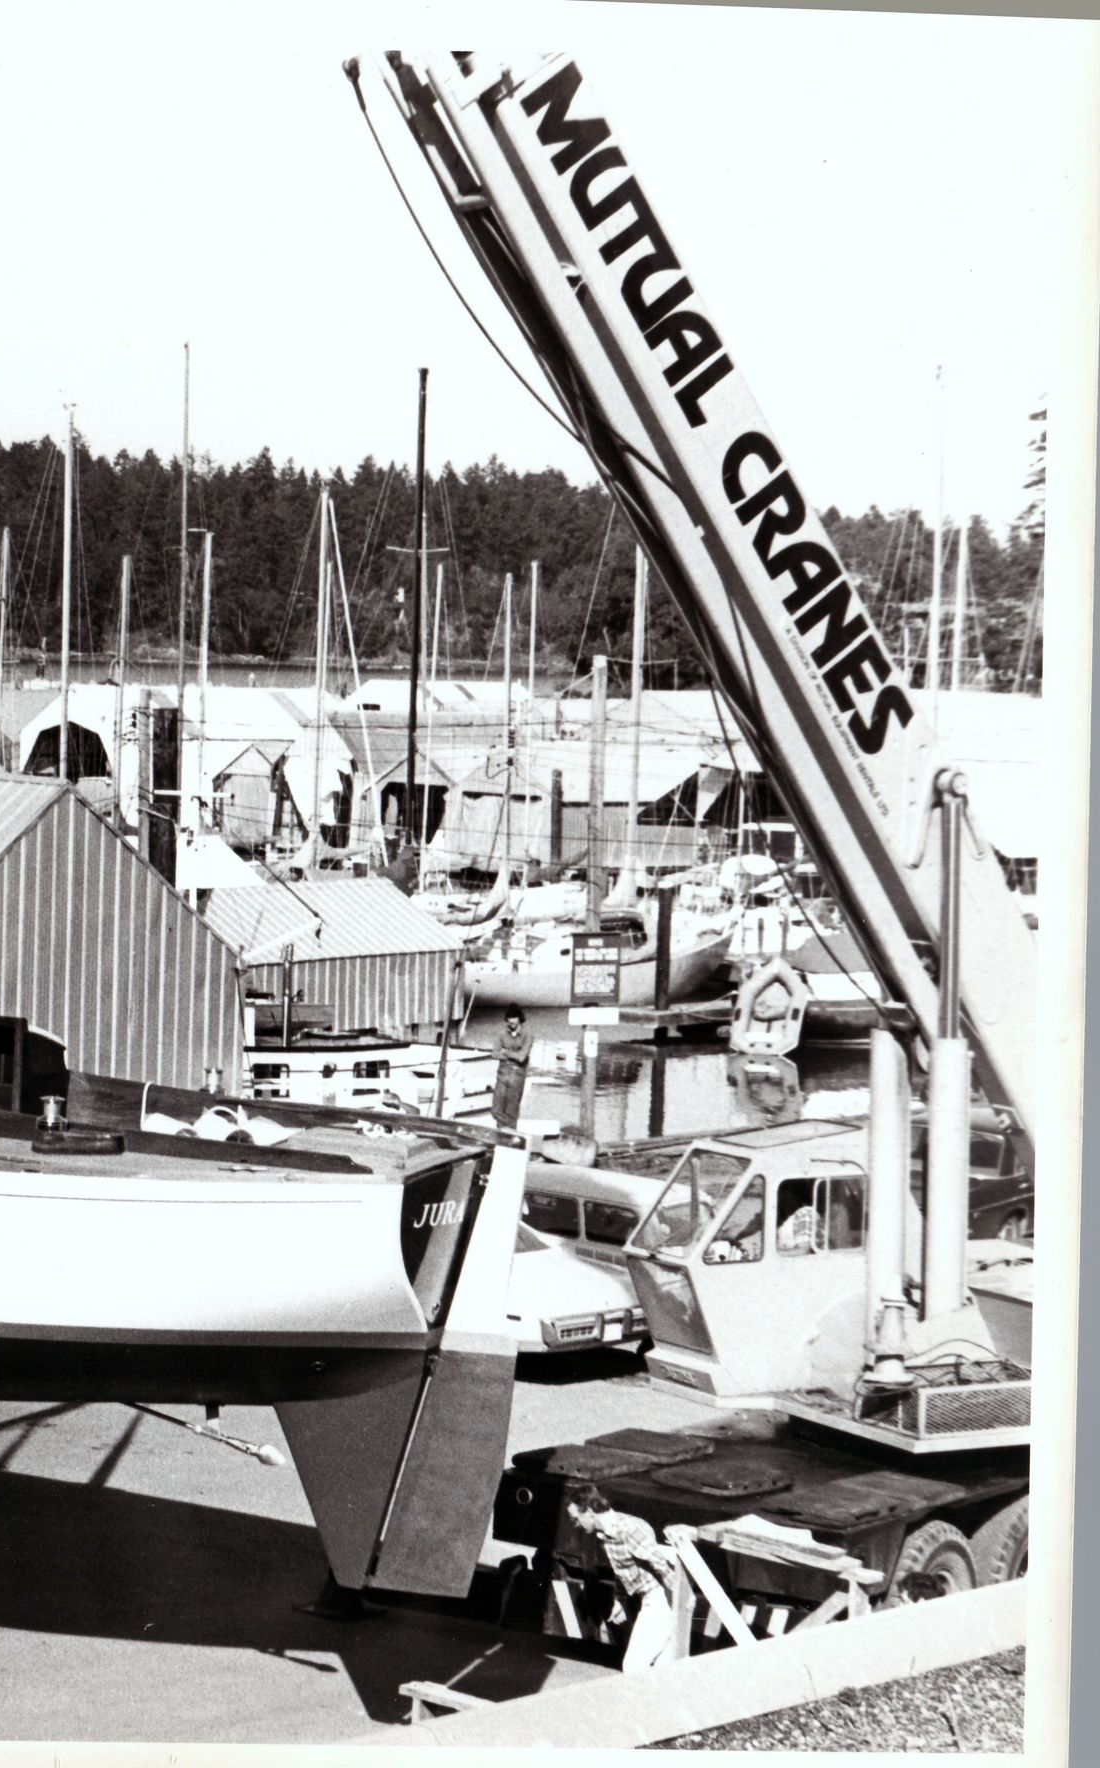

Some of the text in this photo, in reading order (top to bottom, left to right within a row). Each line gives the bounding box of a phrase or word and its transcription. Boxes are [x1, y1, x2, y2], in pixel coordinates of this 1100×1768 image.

[520, 61, 915, 755] MUTUAL CRANES
[790, 635, 810, 671] DIVISION
[832, 715, 860, 761] EQUIPMENT
[856, 763, 880, 799] RENTALS
[413, 1200, 466, 1229] JURA
